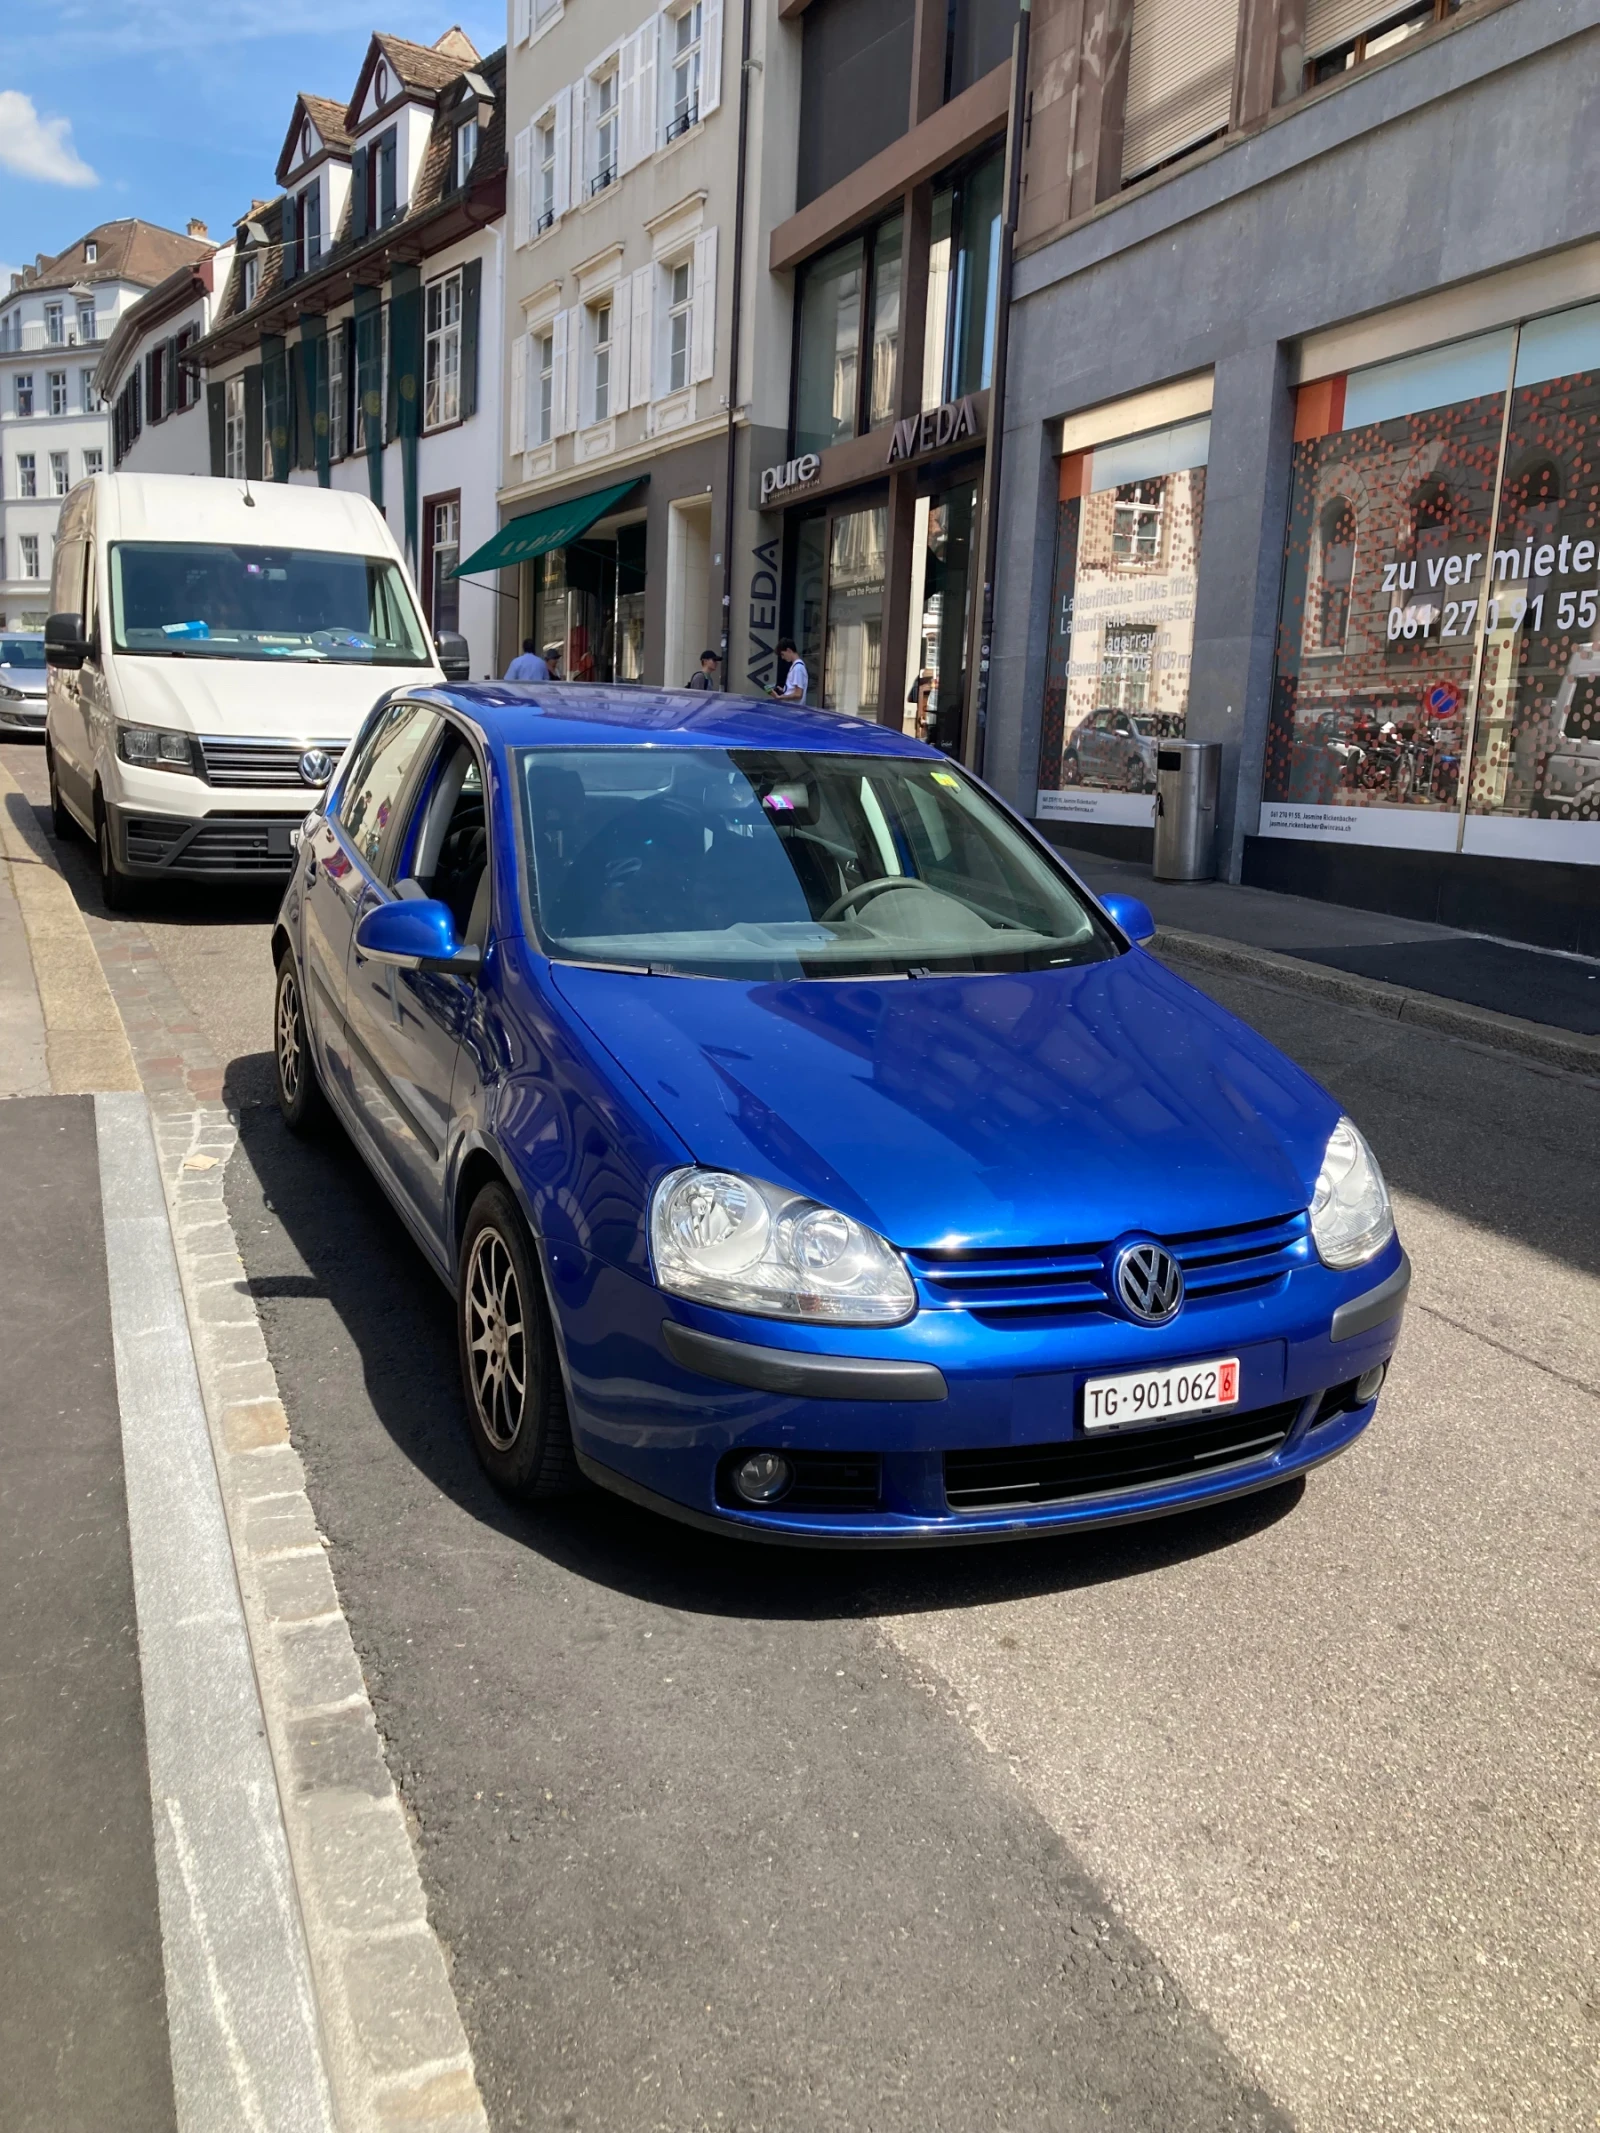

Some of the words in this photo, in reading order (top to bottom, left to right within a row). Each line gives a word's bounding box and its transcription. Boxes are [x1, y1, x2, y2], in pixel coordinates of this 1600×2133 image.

[886, 395, 977, 464] AVEDA
[760, 453, 820, 504] pure
[1381, 561, 1417, 592] zu
[746, 538, 780, 692] AVEDA
[1387, 603, 1432, 640] 061
[1510, 594, 1545, 632] 91
[1556, 589, 1599, 631] 55
